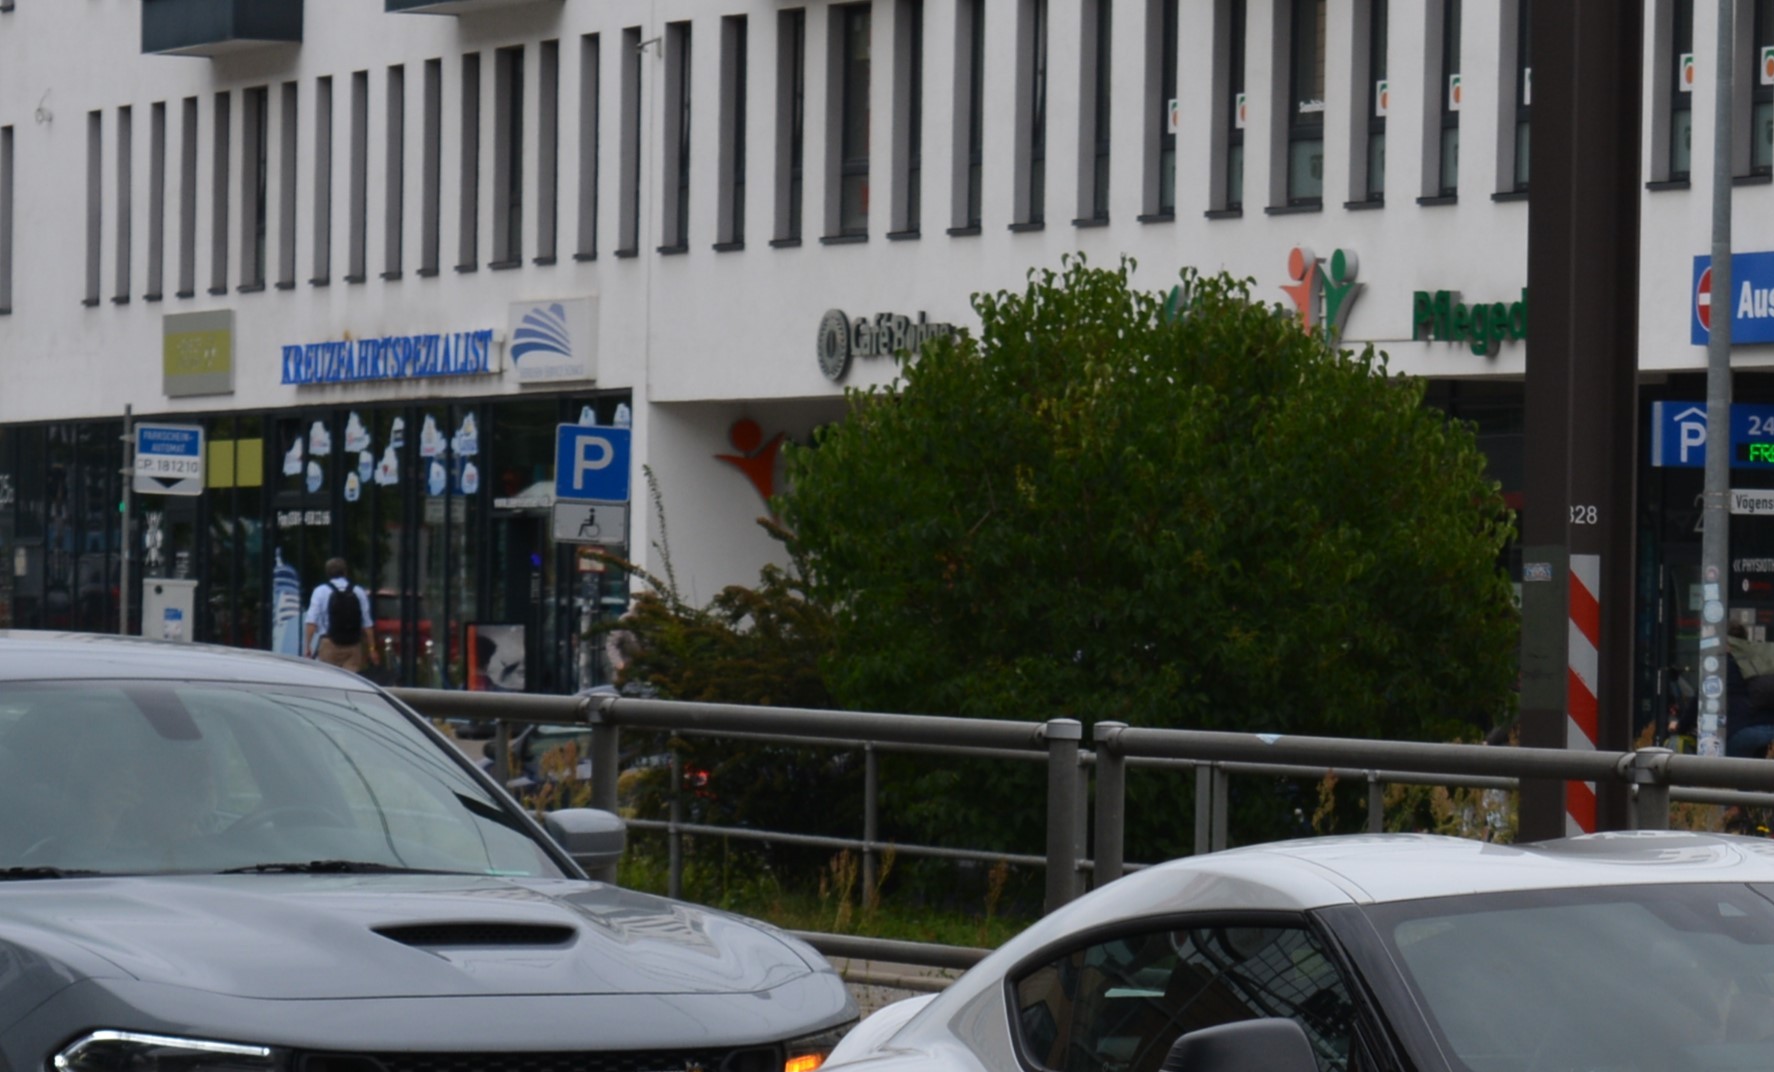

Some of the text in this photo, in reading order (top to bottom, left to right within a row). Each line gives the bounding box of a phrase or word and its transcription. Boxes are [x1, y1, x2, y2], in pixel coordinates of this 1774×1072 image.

[850, 312, 894, 357] Café
[1413, 288, 1528, 356] Pfleged
[280, 328, 494, 385] KREUZFAHRTSPEZIALIST
[573, 435, 614, 491] P
[1680, 421, 1707, 463] P
